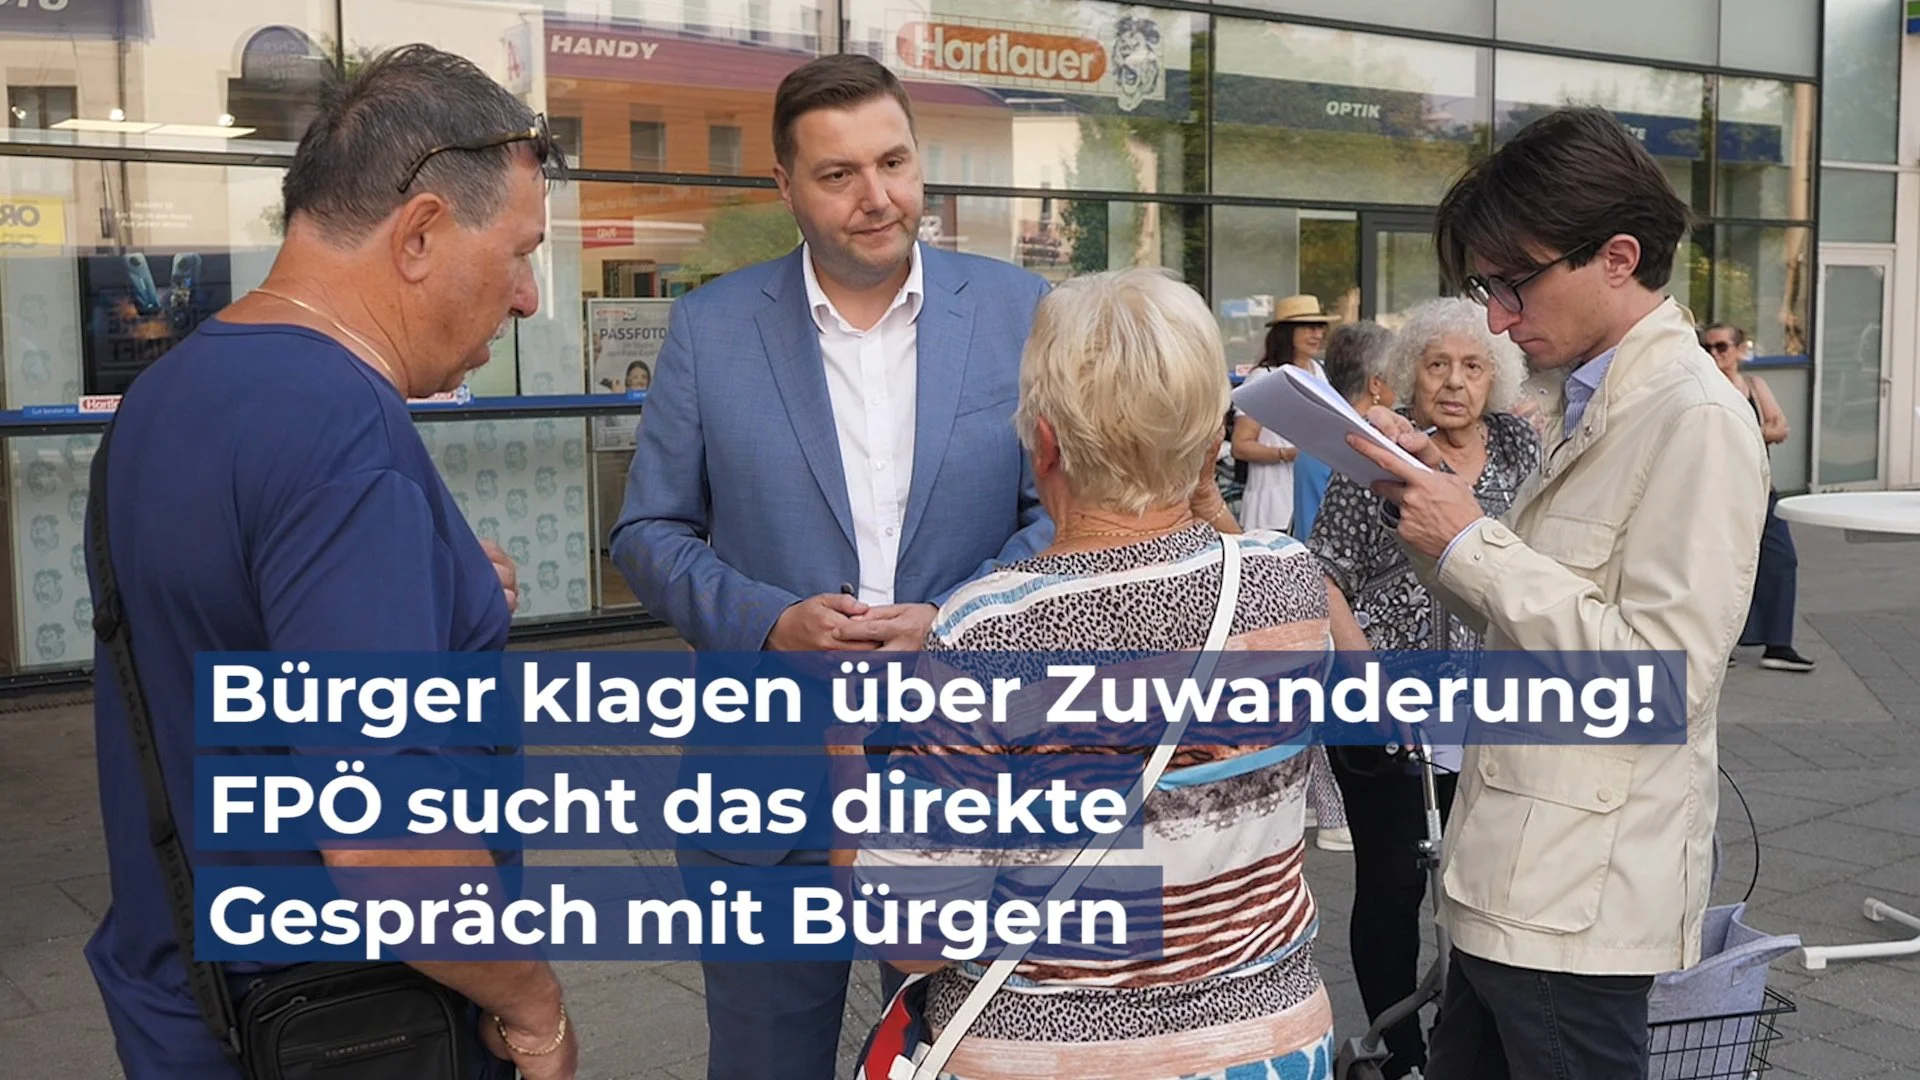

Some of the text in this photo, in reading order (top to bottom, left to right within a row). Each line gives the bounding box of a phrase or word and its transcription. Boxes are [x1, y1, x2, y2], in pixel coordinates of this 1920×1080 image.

[551, 35, 659, 60] HANDY
[914, 23, 1094, 80] Hartlauer
[1326, 101, 1380, 119] OPTIK
[599, 327, 667, 340] PASSFOTO
